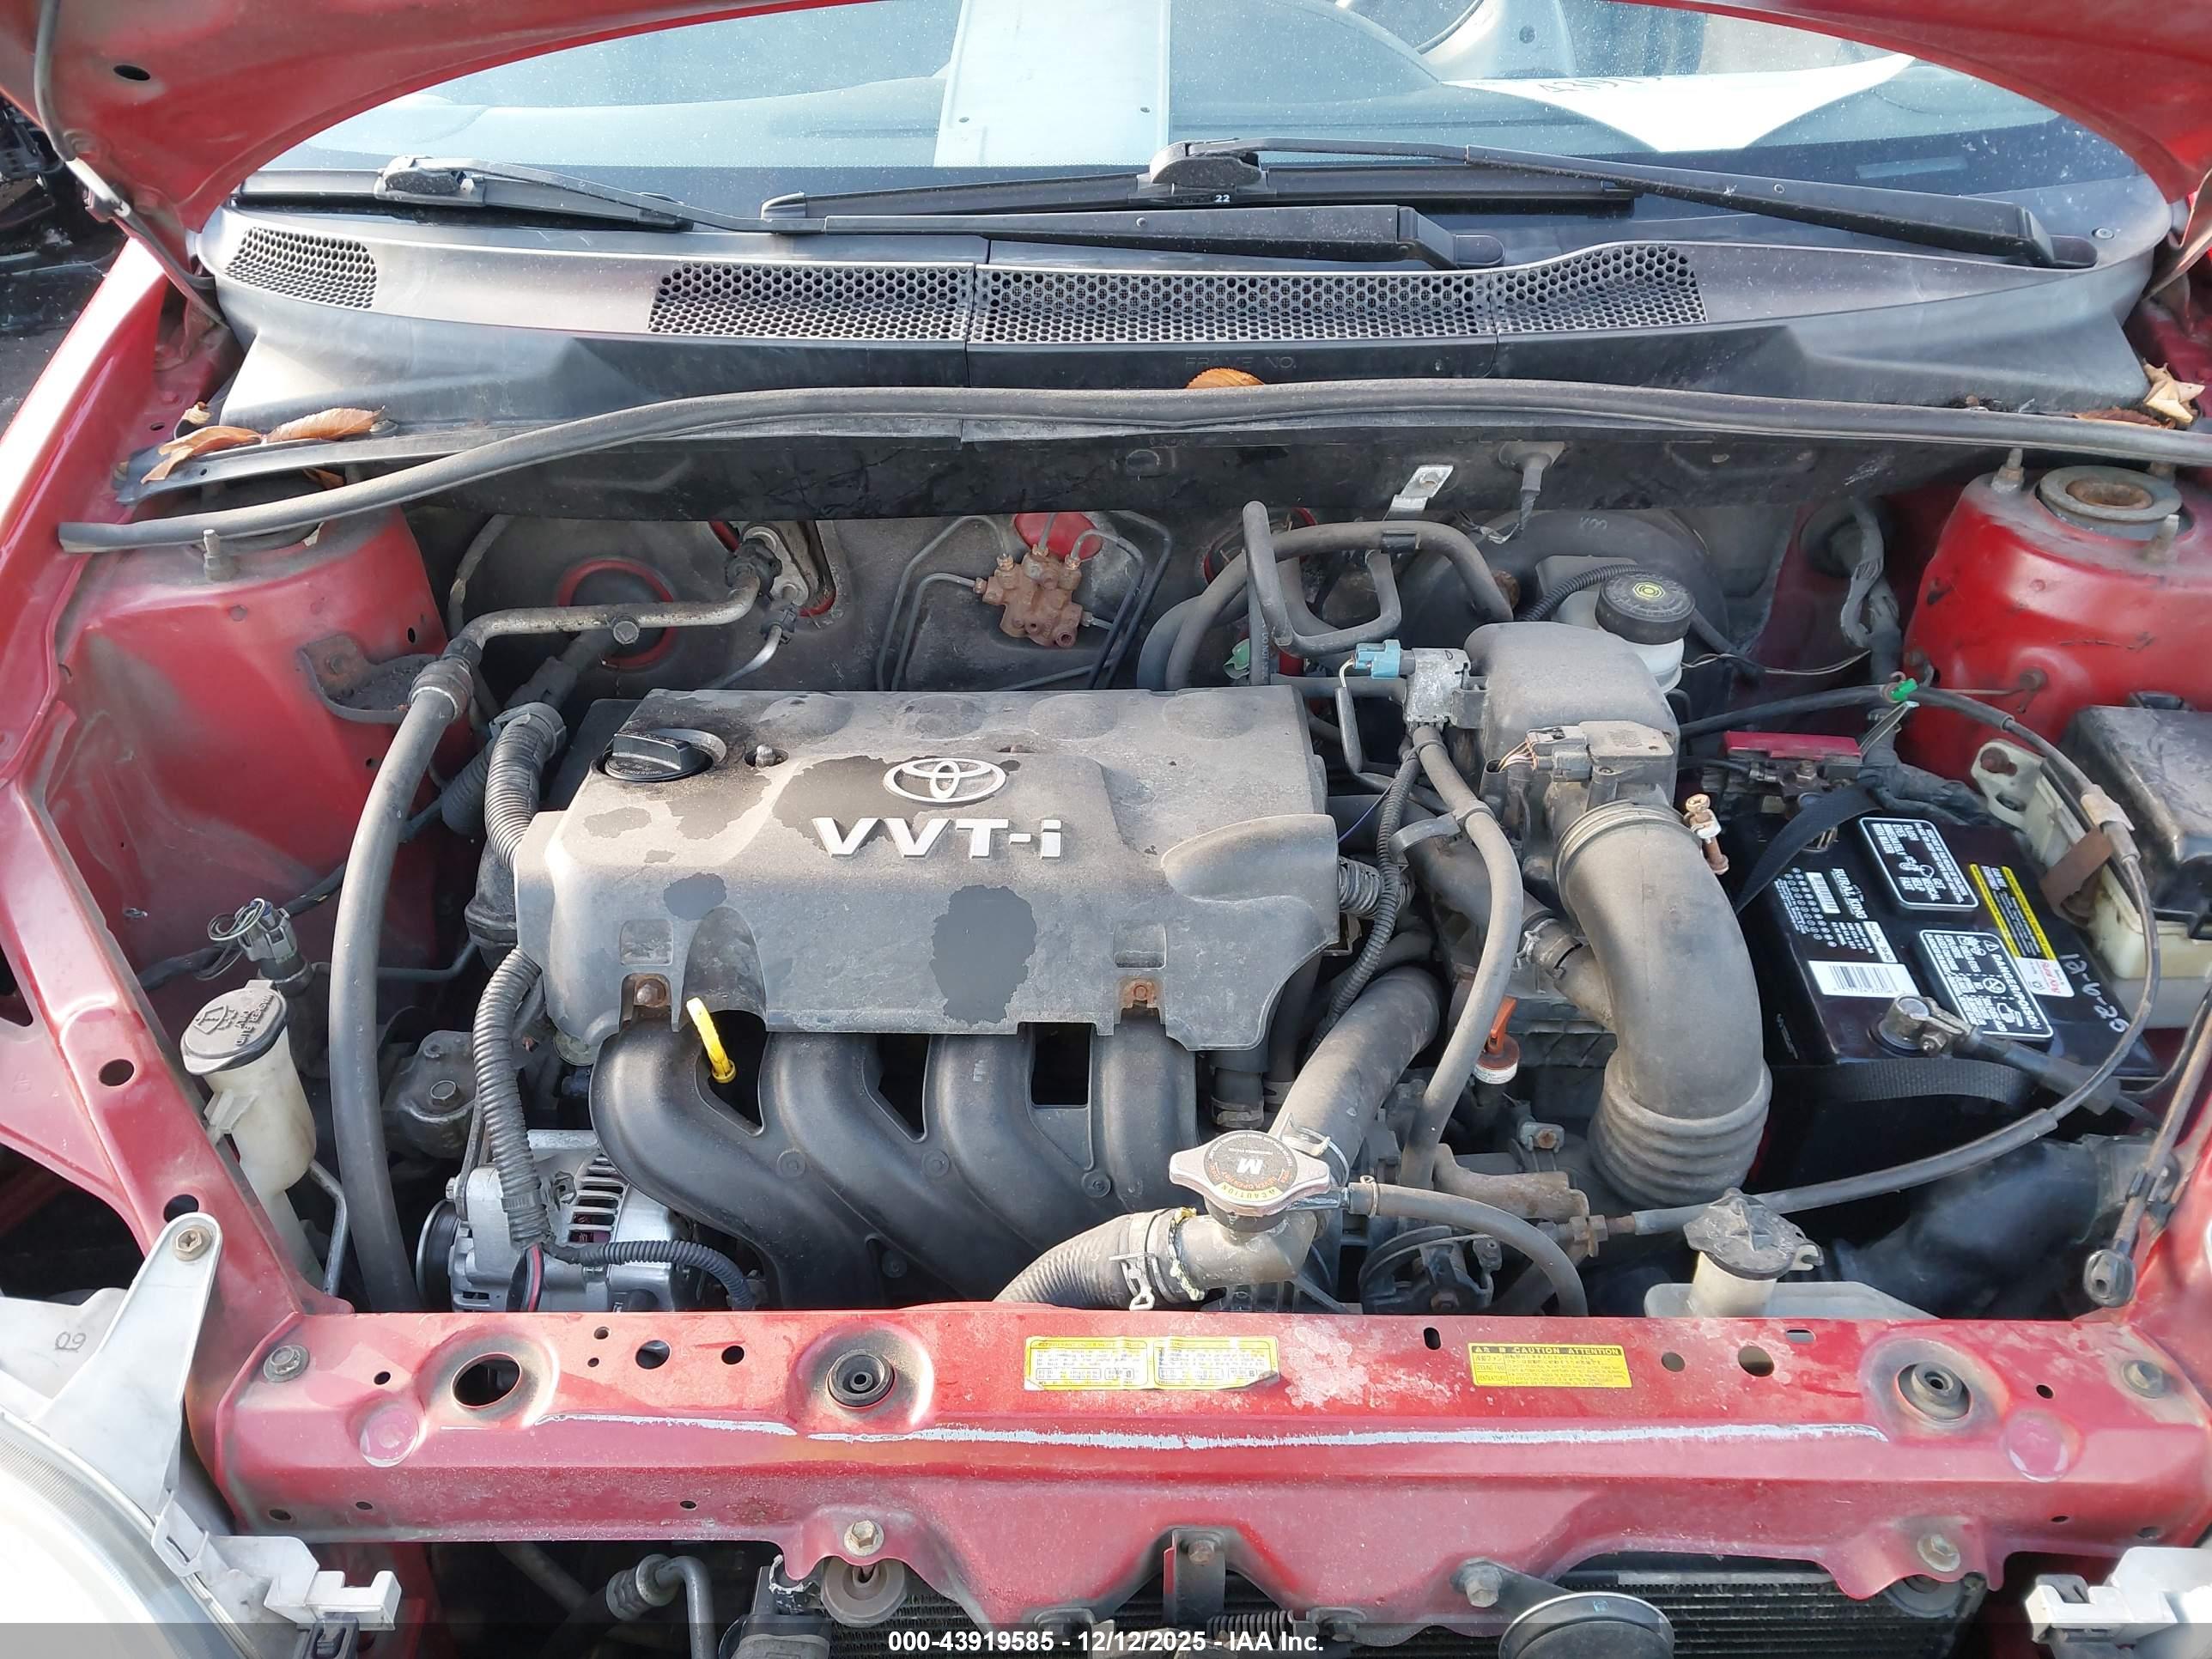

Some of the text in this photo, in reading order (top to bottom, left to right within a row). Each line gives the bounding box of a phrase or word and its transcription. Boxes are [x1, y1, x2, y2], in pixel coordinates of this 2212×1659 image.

[1214, 194, 1231, 203] 22
[1266, 356, 1297, 368] NO.
[1892, 824, 1908, 837] EYES
[1902, 824, 1920, 841] FLUSH
[811, 817, 1063, 860] VVT-i
[1898, 876, 1916, 890] FAST
[1909, 877, 1927, 891] HELP
[1930, 878, 1947, 890] GET
[1831, 868, 1857, 896] RURAL
[1846, 897, 1869, 919] KING
[1990, 953, 2043, 1030] DANGER/POISON
[1236, 1158, 1264, 1176] M
[1234, 1178, 1254, 1189] OPEN
[1254, 1176, 1277, 1190] NEVER
[1221, 1184, 1268, 1200] CAUTION
